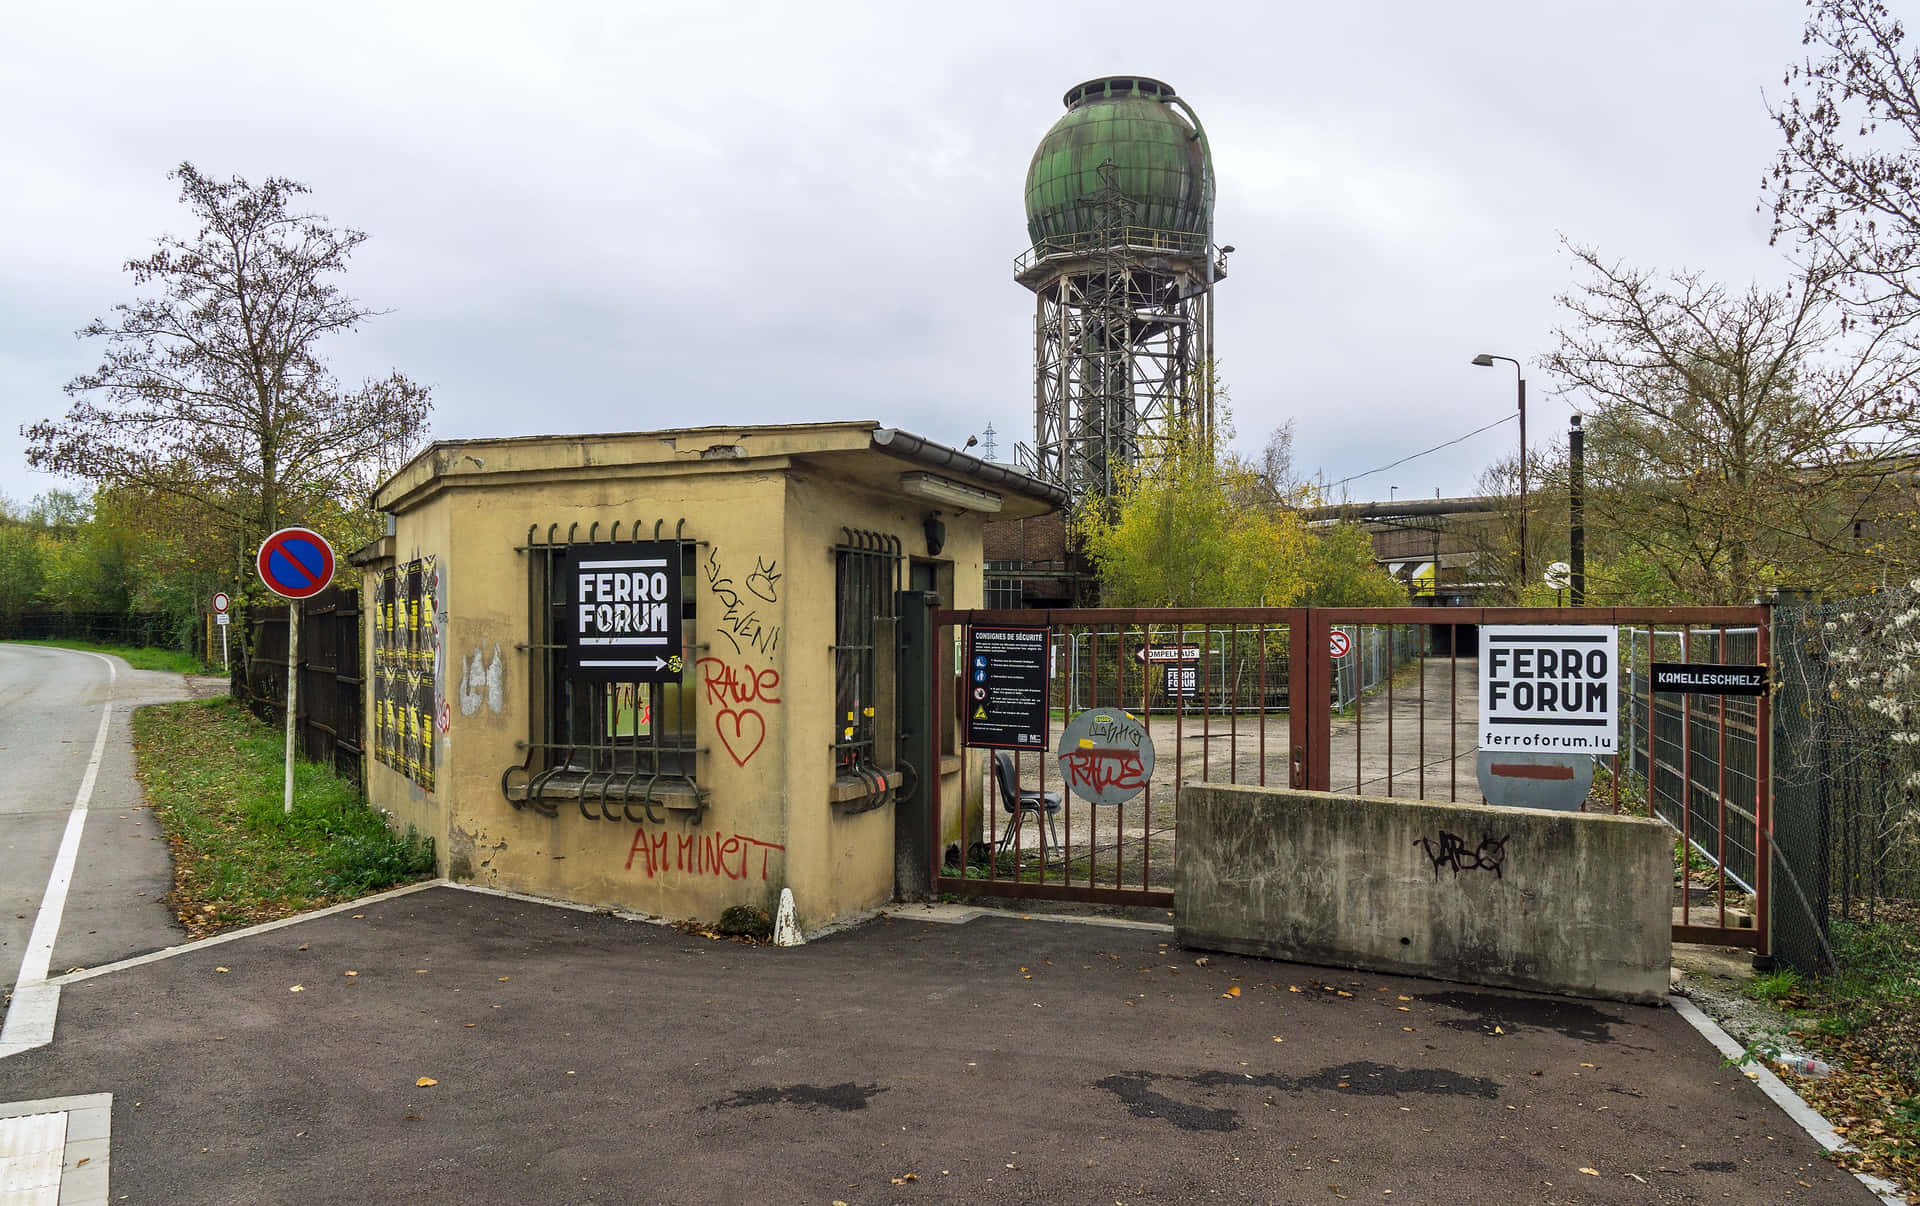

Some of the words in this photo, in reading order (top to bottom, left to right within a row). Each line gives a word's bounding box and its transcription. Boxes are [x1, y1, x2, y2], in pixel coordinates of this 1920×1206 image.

[579, 572, 668, 602] FERRO
[579, 603, 668, 633] FORUM
[1007, 633, 1015, 641] DE
[1144, 650, 1196, 658] OMPELHUS
[1489, 648, 1608, 680] FERRO
[1658, 672, 1761, 686] KAMELLESCHMELZ
[1489, 681, 1608, 713] FORUM
[1486, 732, 1611, 748] ferroforum.lu
